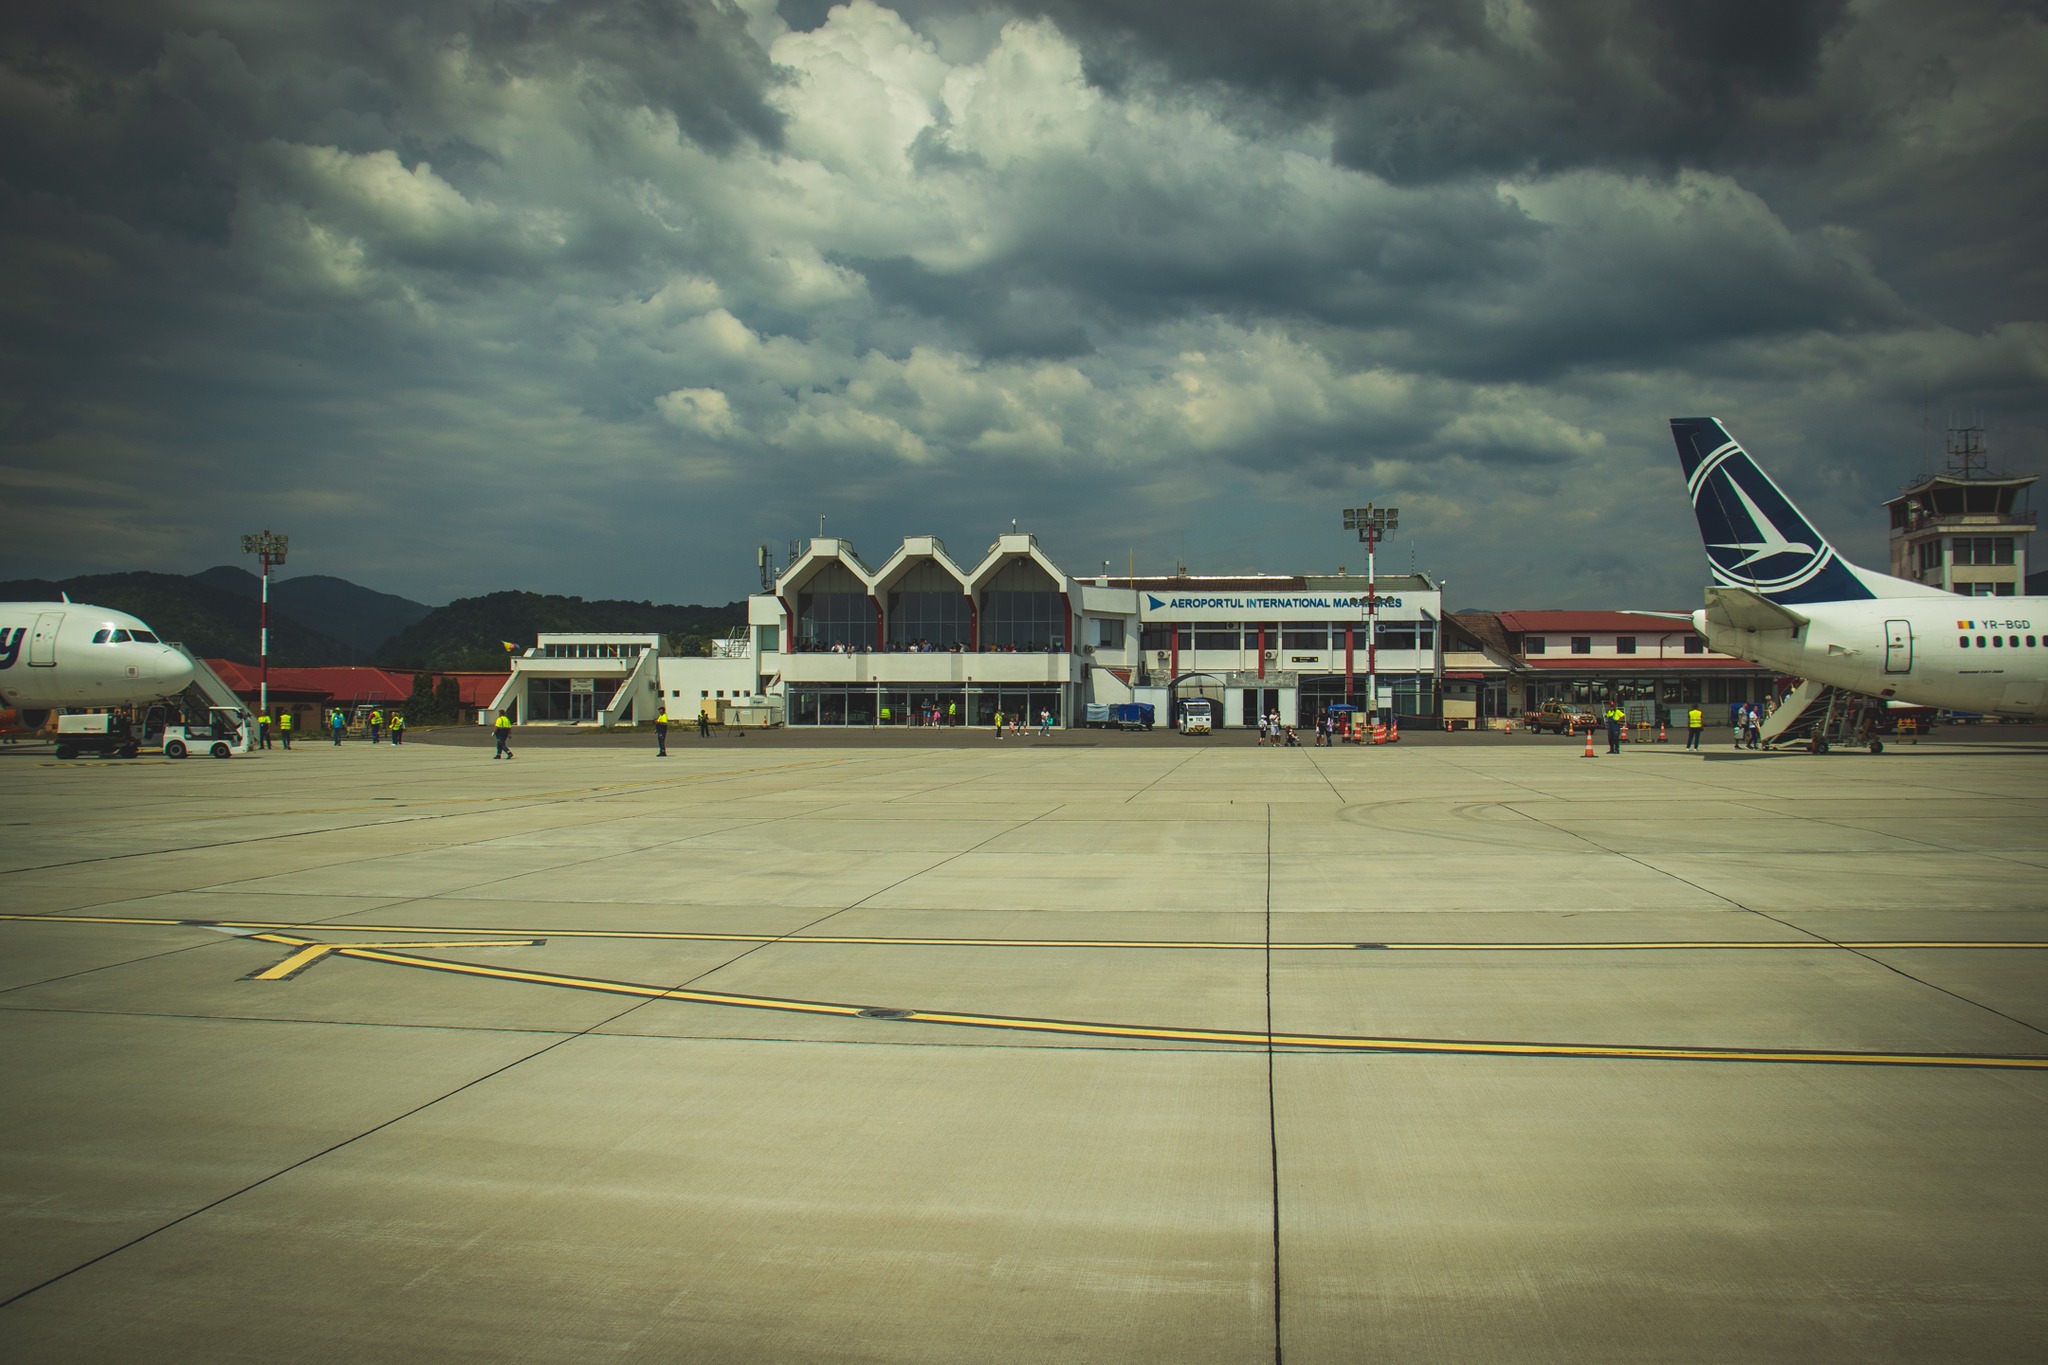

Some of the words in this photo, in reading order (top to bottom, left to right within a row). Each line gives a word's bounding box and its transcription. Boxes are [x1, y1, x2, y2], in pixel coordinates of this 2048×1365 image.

[1169, 598, 1244, 608] AEROPORTUL
[1246, 598, 1331, 608] INTERNATIONAL
[1981, 620, 2031, 629] YR-BGD
